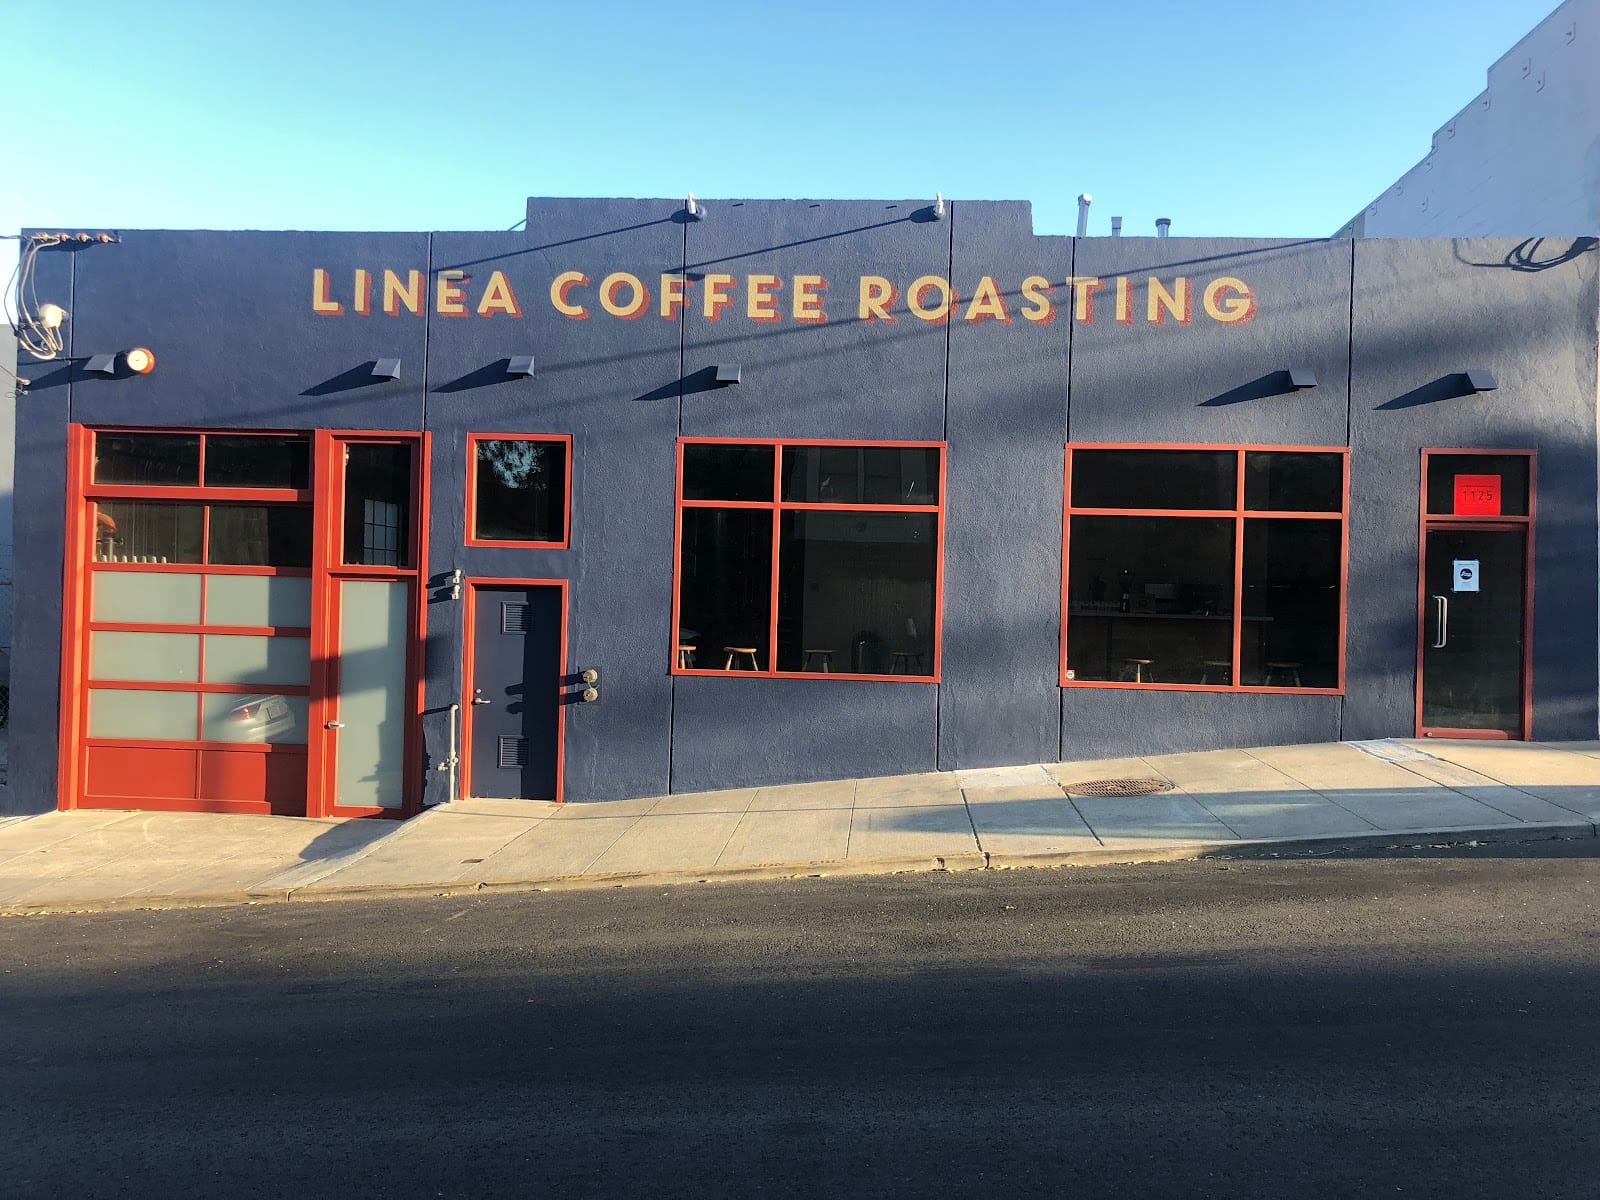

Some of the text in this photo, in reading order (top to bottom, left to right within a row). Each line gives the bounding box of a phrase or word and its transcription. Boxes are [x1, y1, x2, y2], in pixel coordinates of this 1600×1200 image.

[313, 268, 1256, 325] LINEA COFFEE ROASTING
[1463, 490, 1493, 501] 1125
